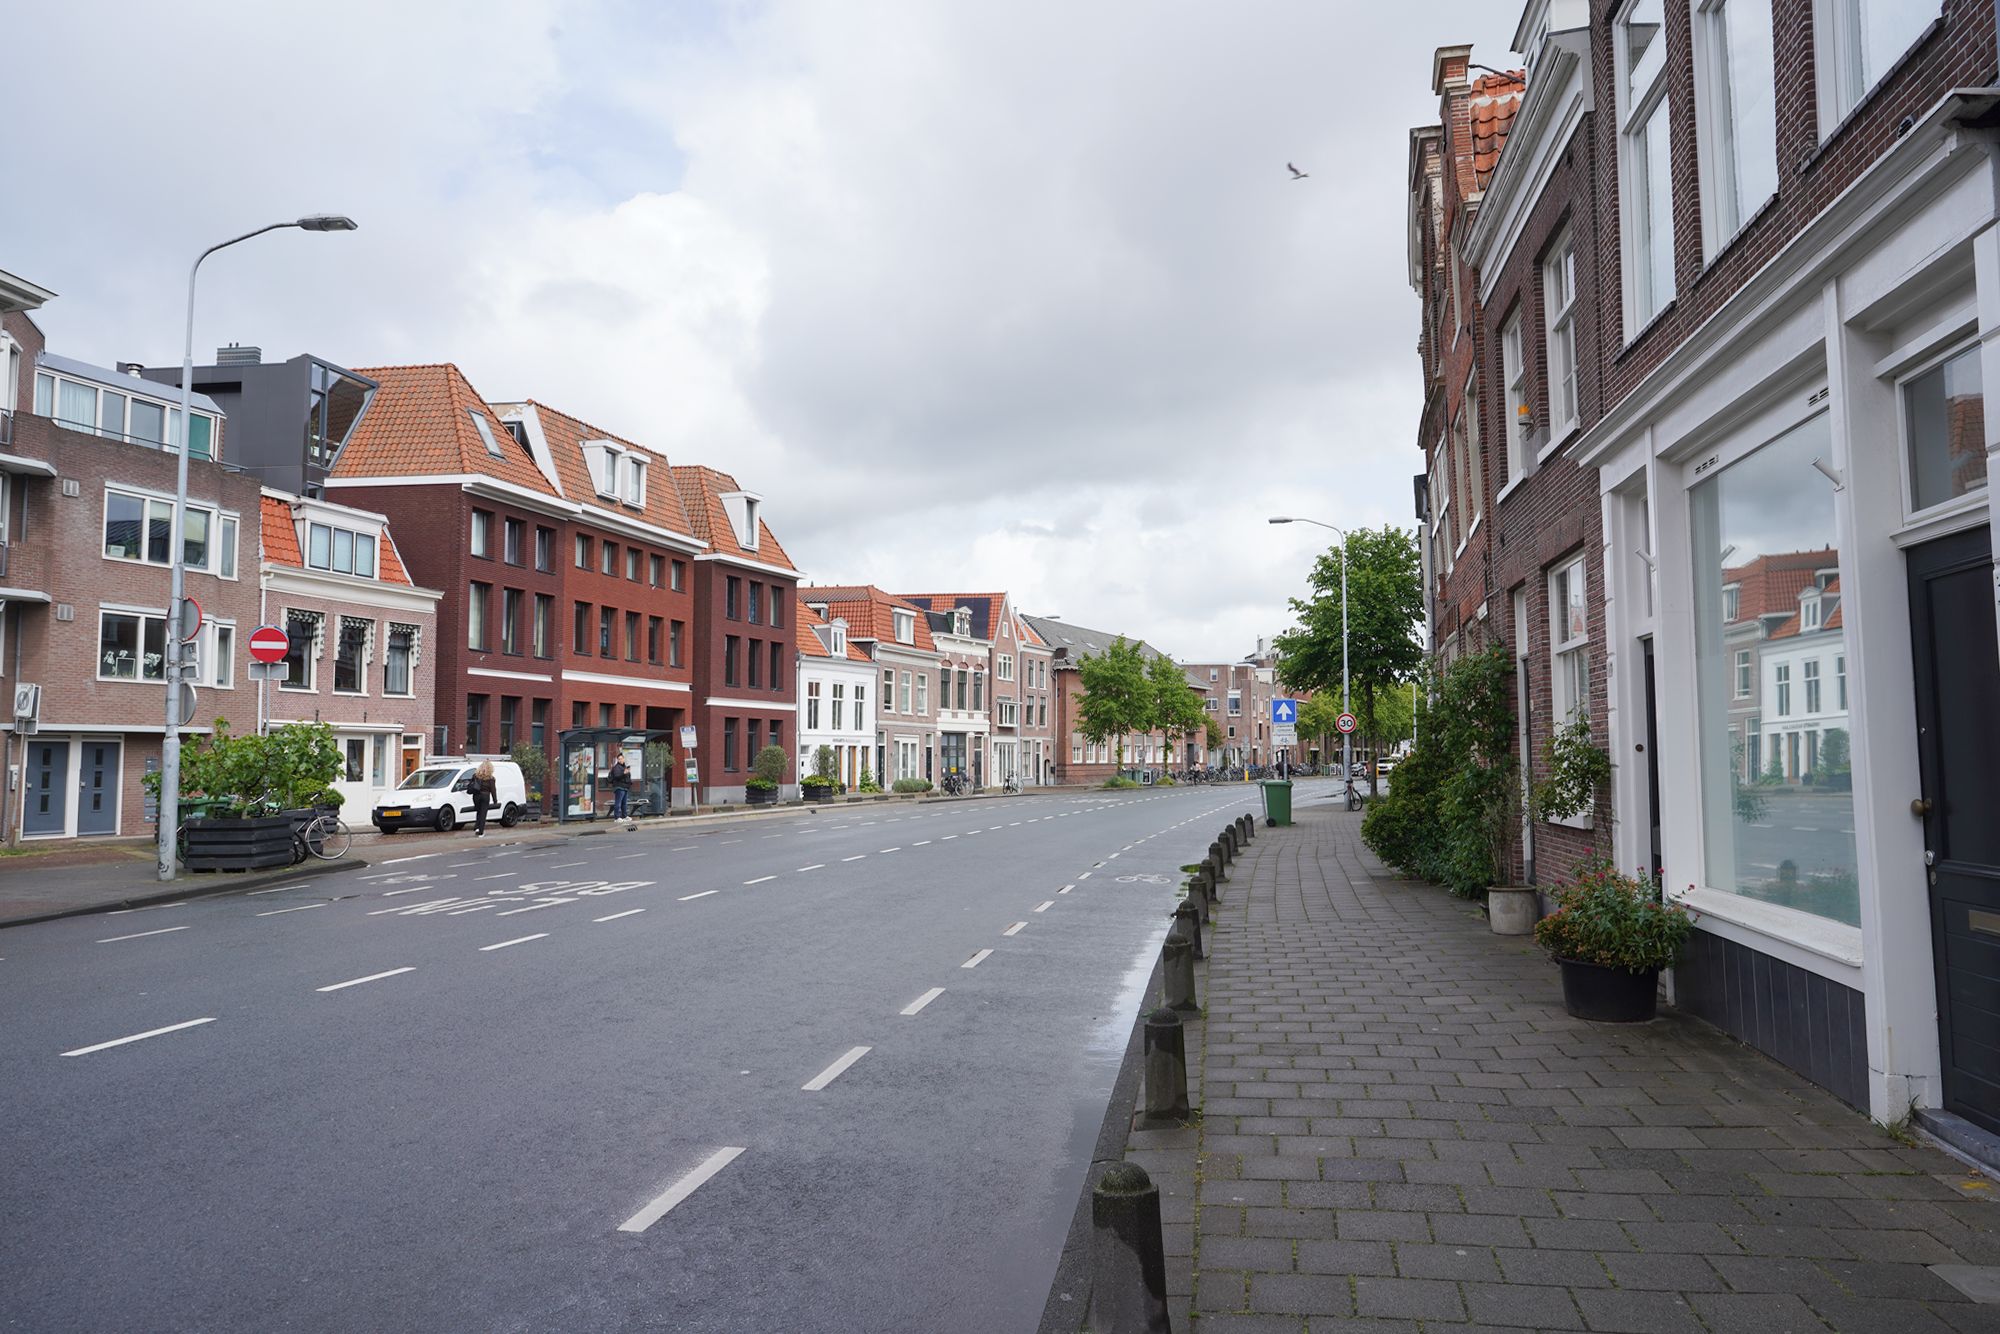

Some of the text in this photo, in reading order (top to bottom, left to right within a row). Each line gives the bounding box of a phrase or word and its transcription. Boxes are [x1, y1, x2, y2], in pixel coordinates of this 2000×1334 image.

[1340, 719, 1353, 728] 30
[487, 880, 657, 896] BUS
[366, 897, 580, 916] LIJN
